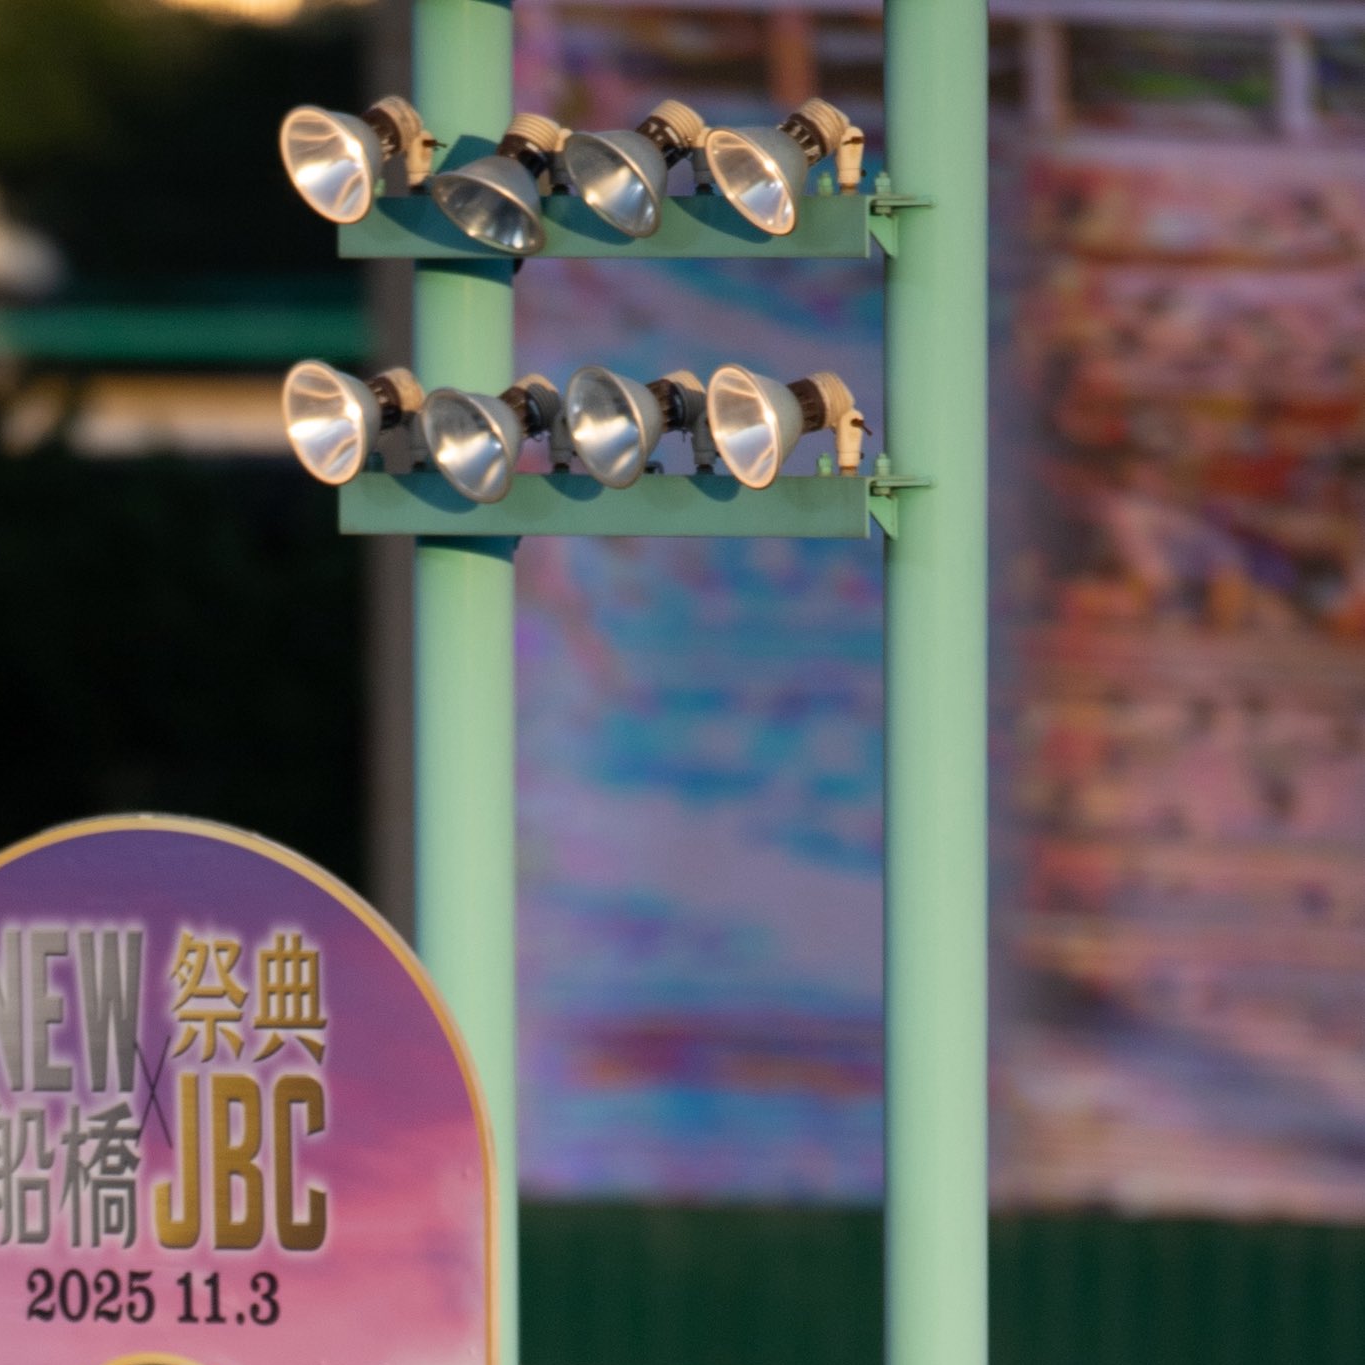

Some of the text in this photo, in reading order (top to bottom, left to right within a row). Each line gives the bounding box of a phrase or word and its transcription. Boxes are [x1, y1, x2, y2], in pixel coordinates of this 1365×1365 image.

[170, 929, 328, 1066] 祭典
[153, 1072, 328, 1252] JBC
[26, 1267, 281, 1327] 2025 11.3
